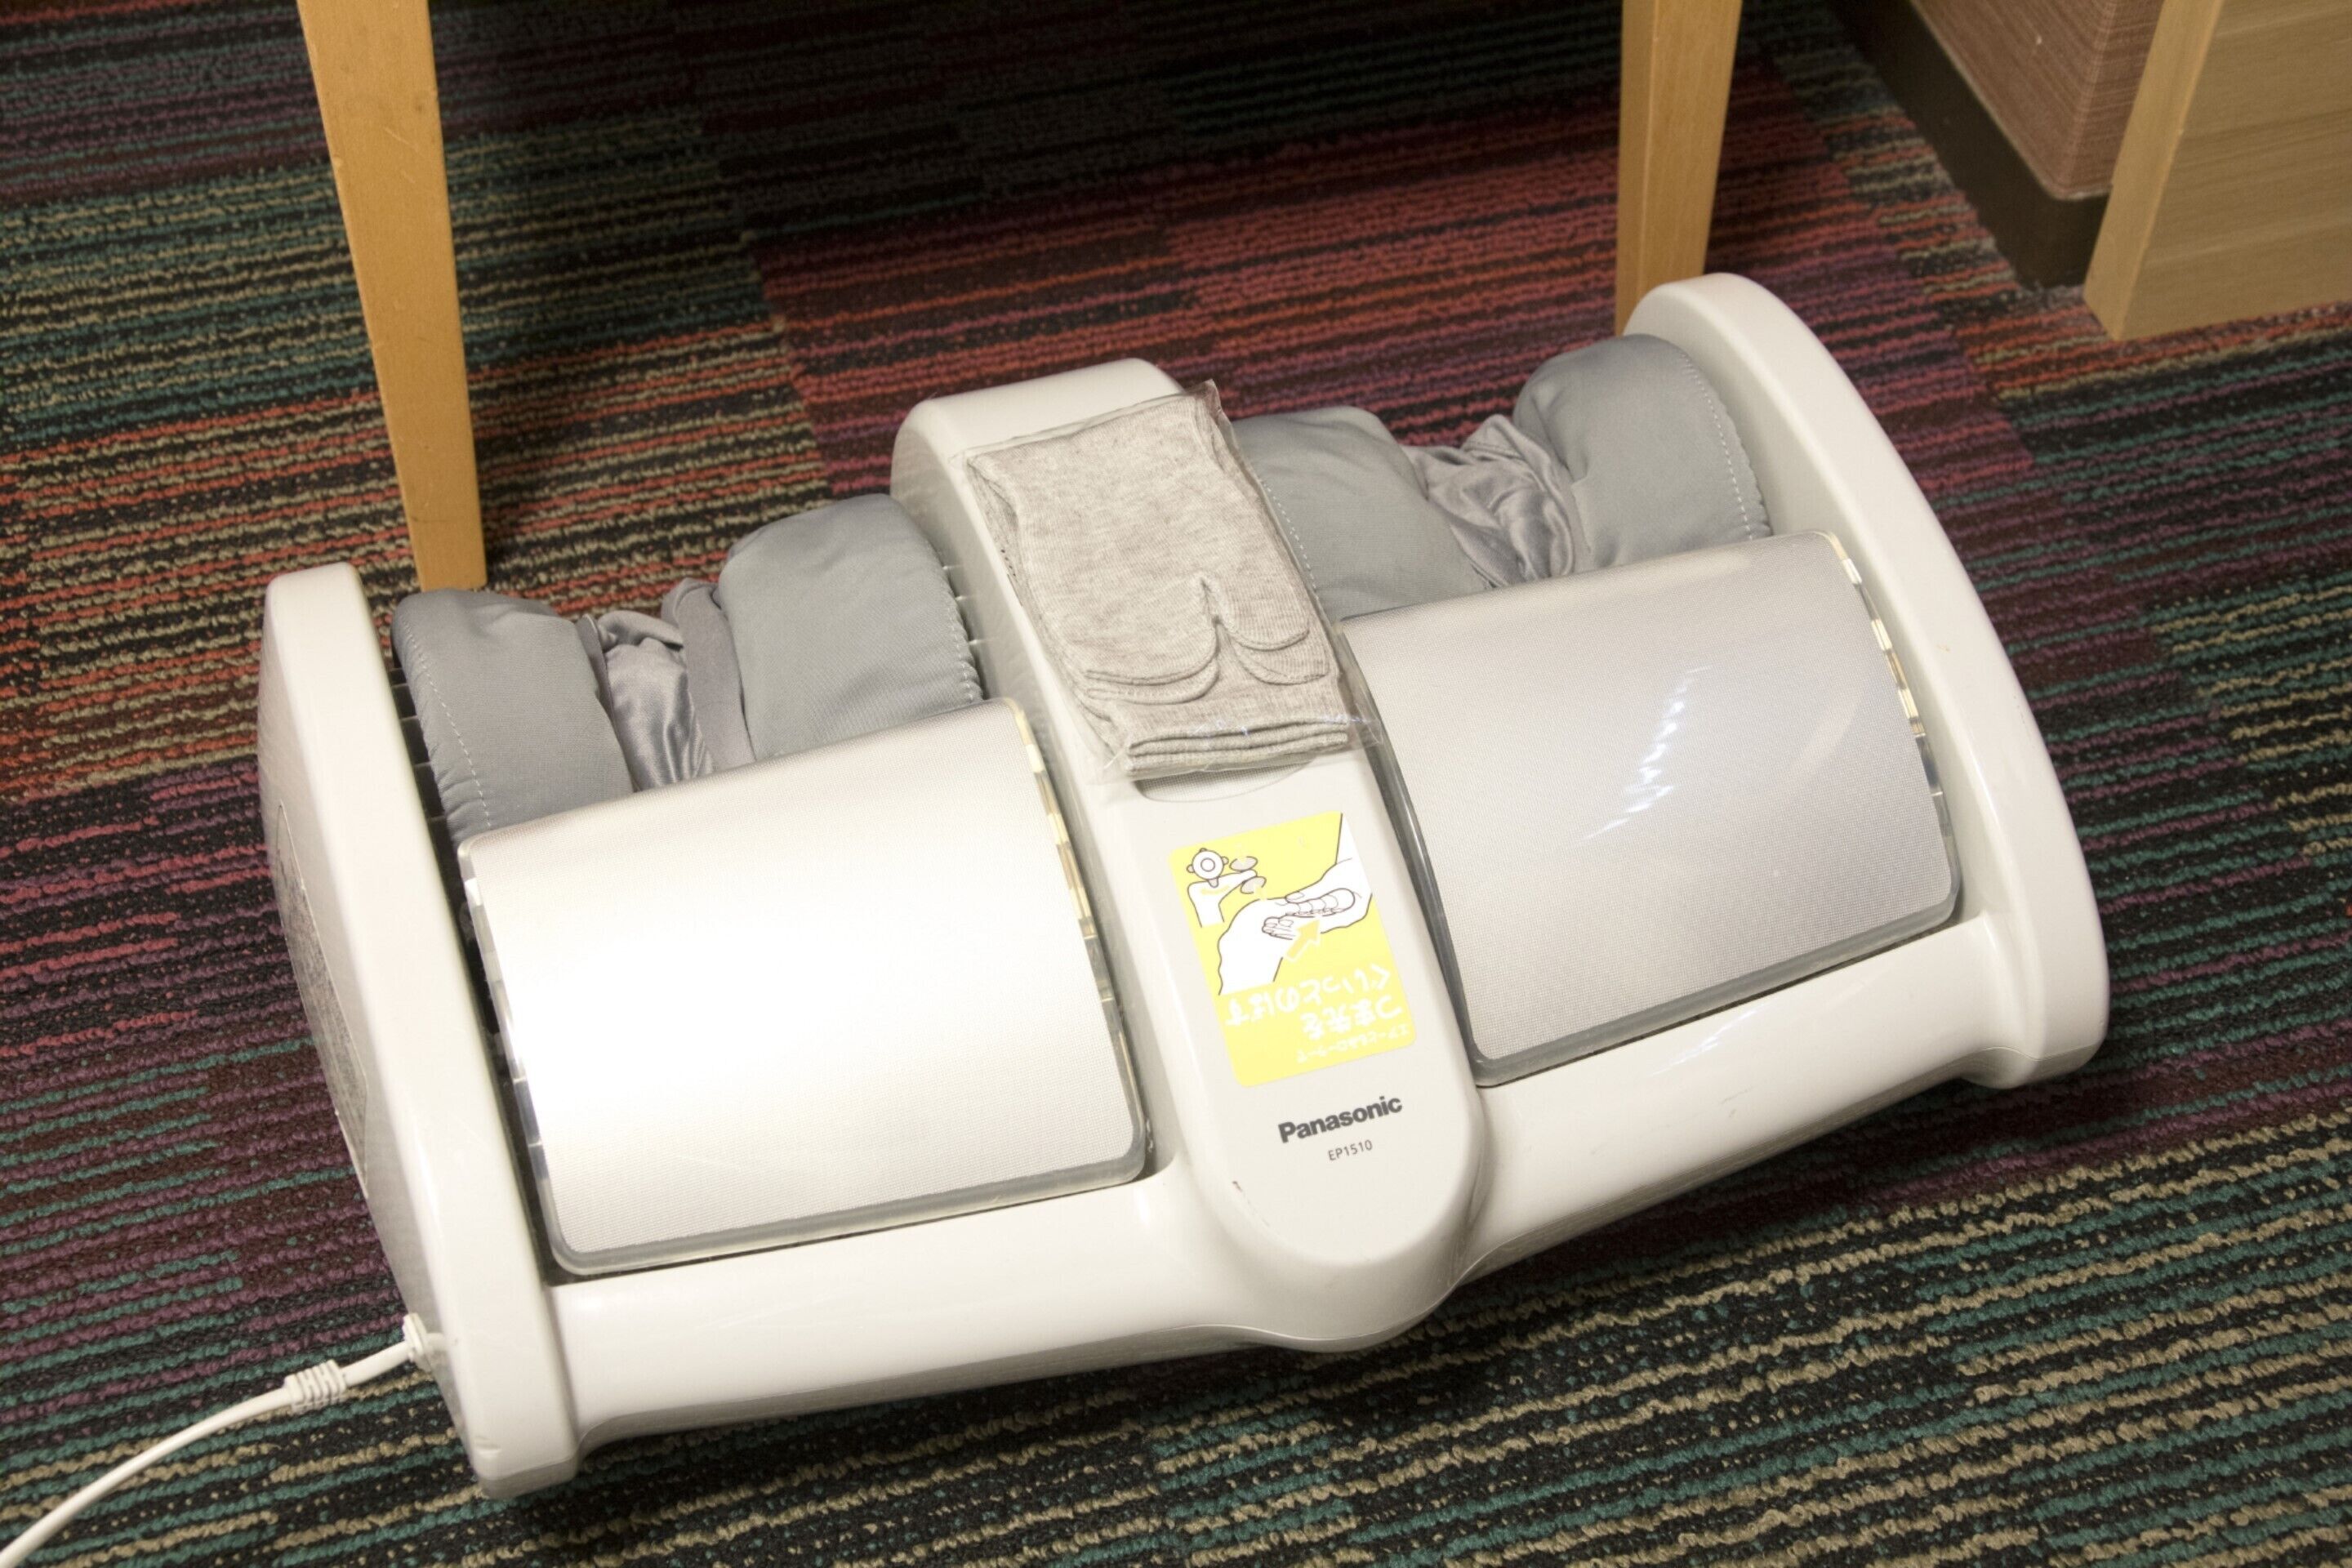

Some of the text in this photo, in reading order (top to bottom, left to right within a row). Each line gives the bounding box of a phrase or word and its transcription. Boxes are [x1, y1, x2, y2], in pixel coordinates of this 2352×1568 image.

[1300, 995, 1402, 1041] つま先を
[1278, 1095, 1403, 1143] Panasonic
[1328, 1139, 1373, 1160] EP1510
